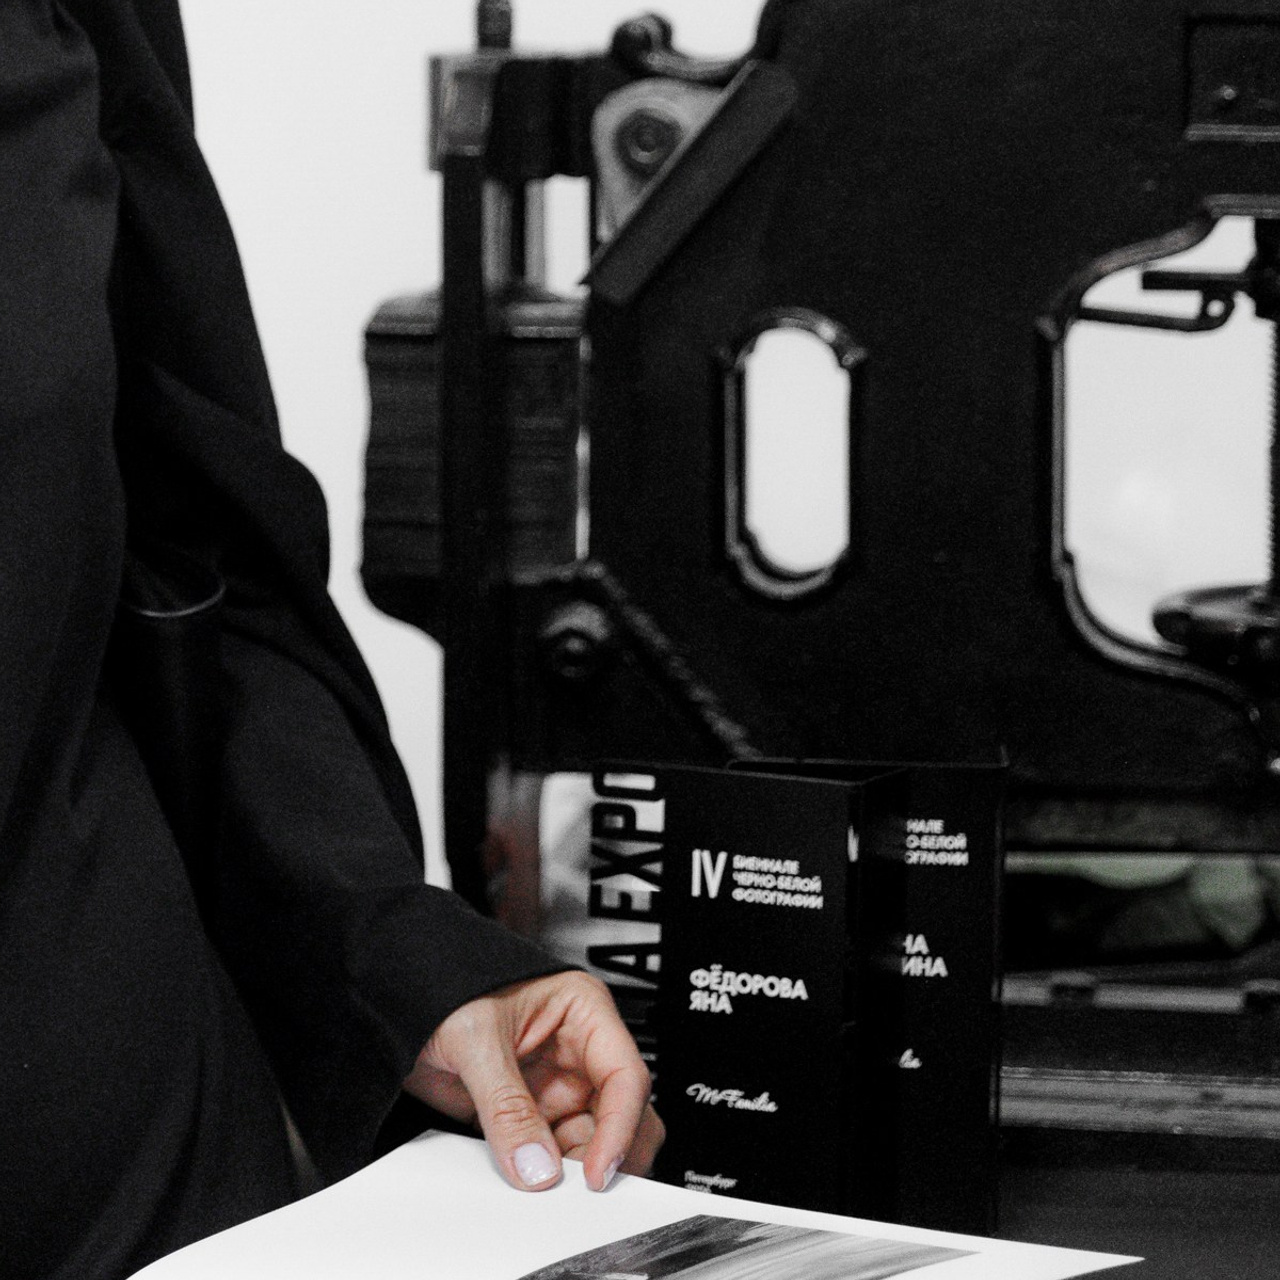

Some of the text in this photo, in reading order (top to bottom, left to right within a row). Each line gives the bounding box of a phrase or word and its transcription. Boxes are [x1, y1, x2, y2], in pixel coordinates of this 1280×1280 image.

[906, 819, 945, 834] НАЛЕ
[906, 832, 968, 850] О-БЕЛОЙ
[732, 854, 800, 875] БИЕННАЛЕ
[904, 850, 969, 866] ОГРАФИИ
[691, 849, 728, 899] IV
[732, 888, 824, 910] ФОТОГРАФИИ
[901, 956, 949, 978] ИНА
[689, 963, 809, 1000] ФЁДОРОВА
[689, 990, 733, 1014] ЯНА
